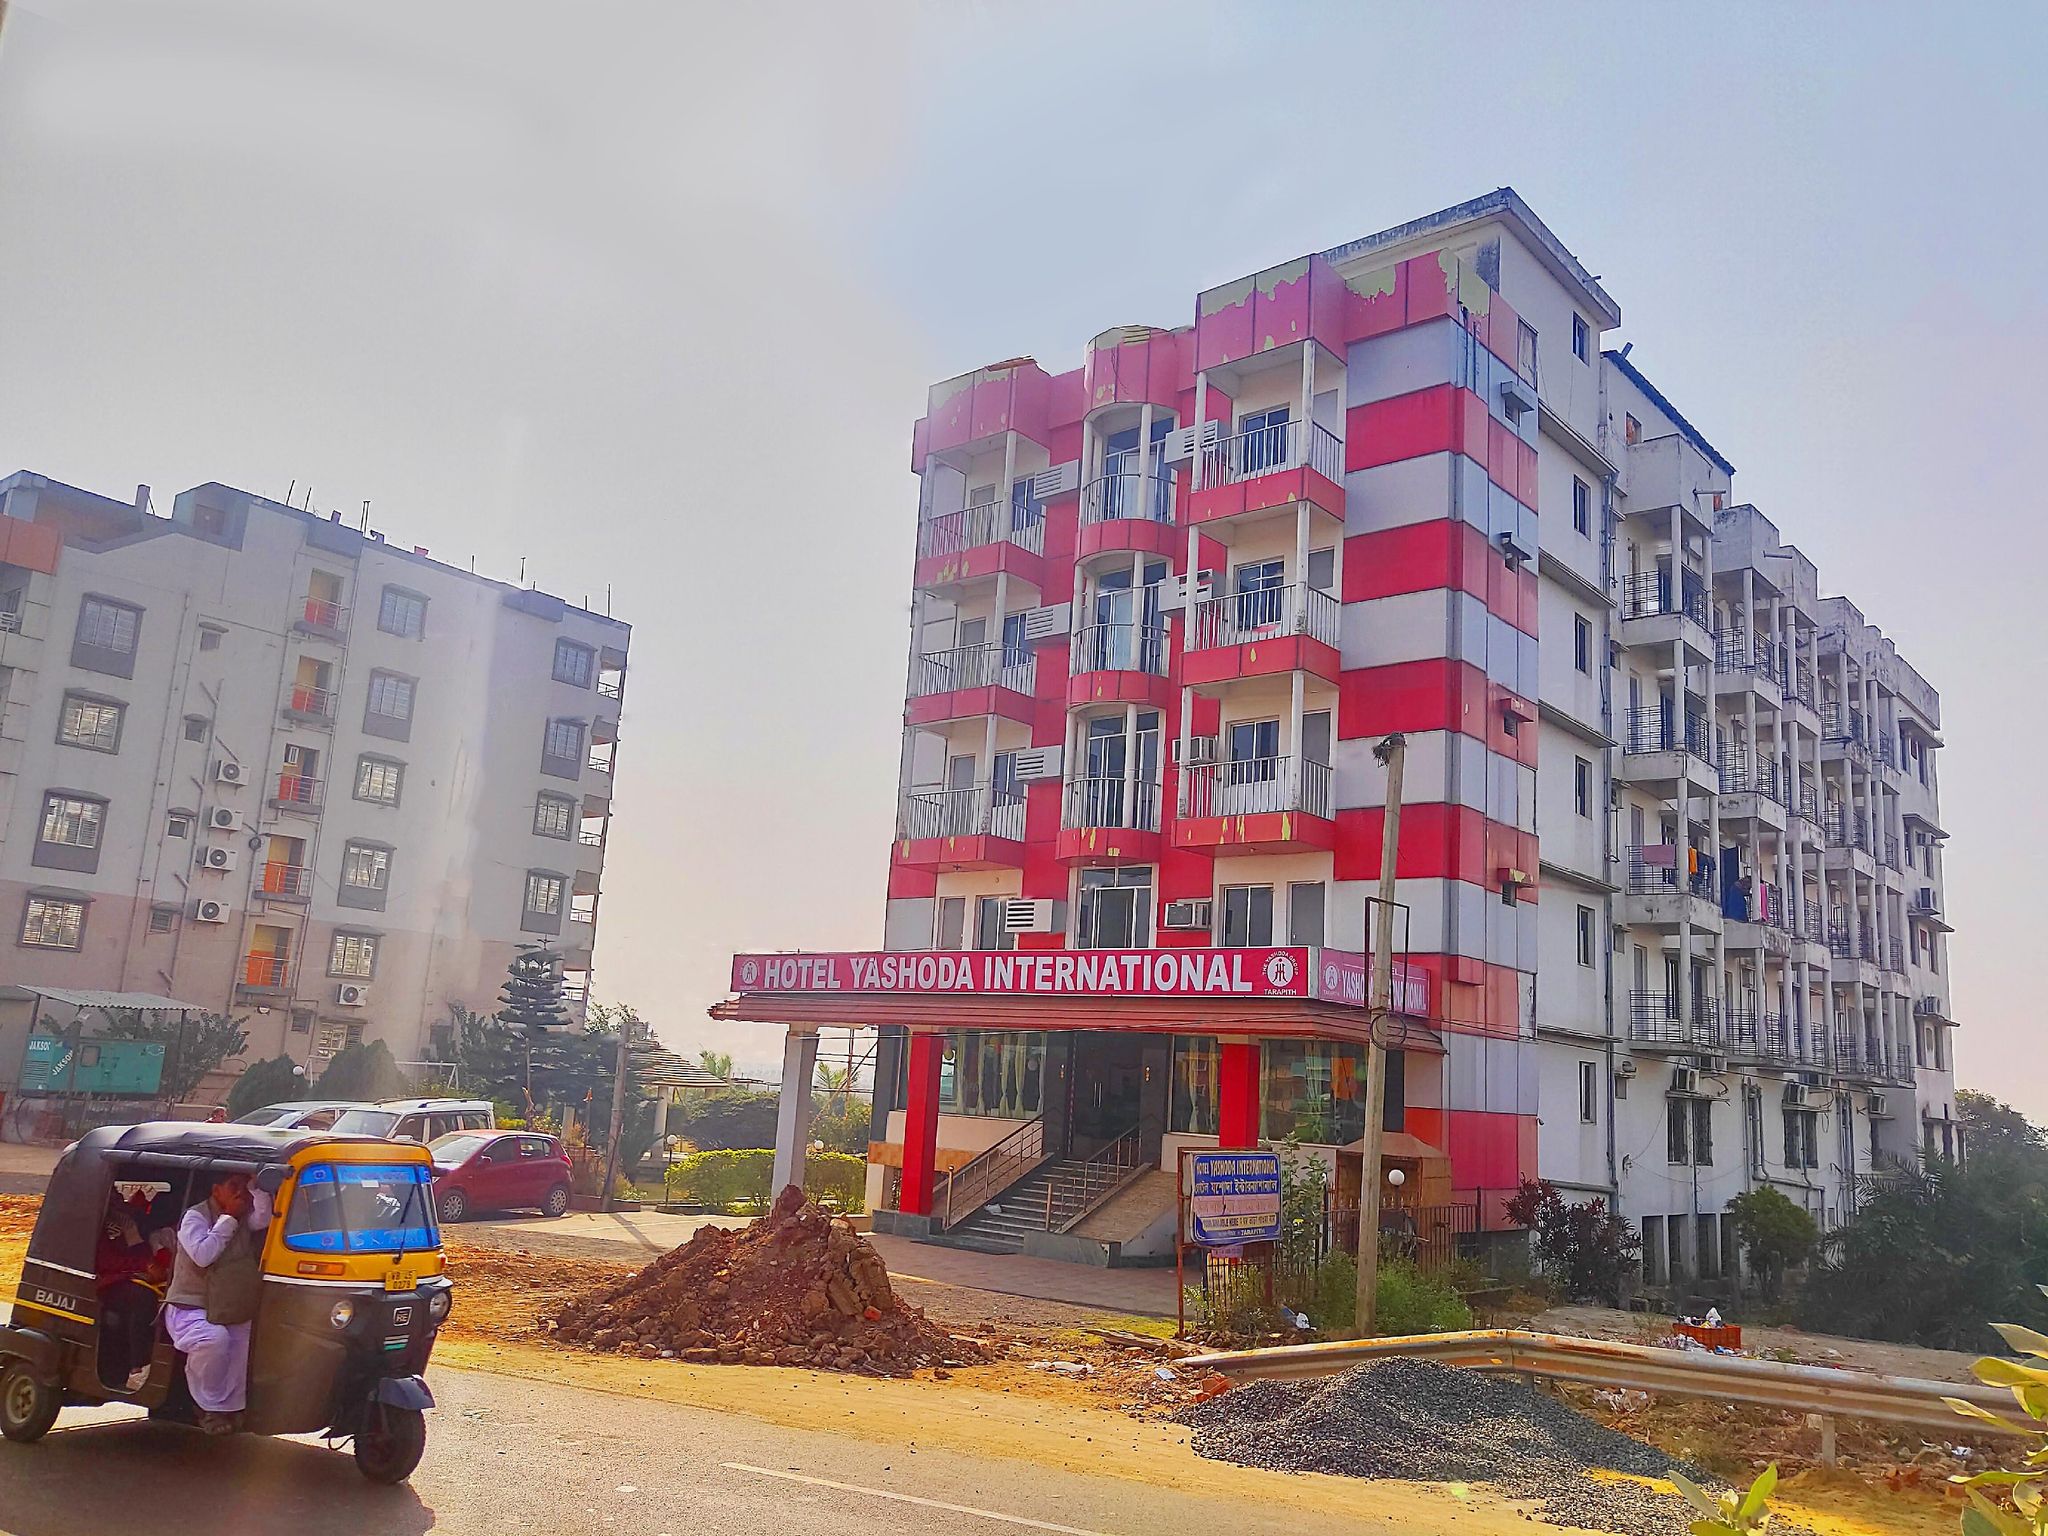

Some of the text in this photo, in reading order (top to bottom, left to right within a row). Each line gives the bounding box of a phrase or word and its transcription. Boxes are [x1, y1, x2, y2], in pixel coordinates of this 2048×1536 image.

[763, 958, 841, 989] HOTEL
[849, 956, 975, 990] YASHODA
[983, 953, 1253, 992] INTERNATIONAL
[1264, 988, 1297, 996] TARAPITH
[35, 1288, 77, 1311] BAJAJ
